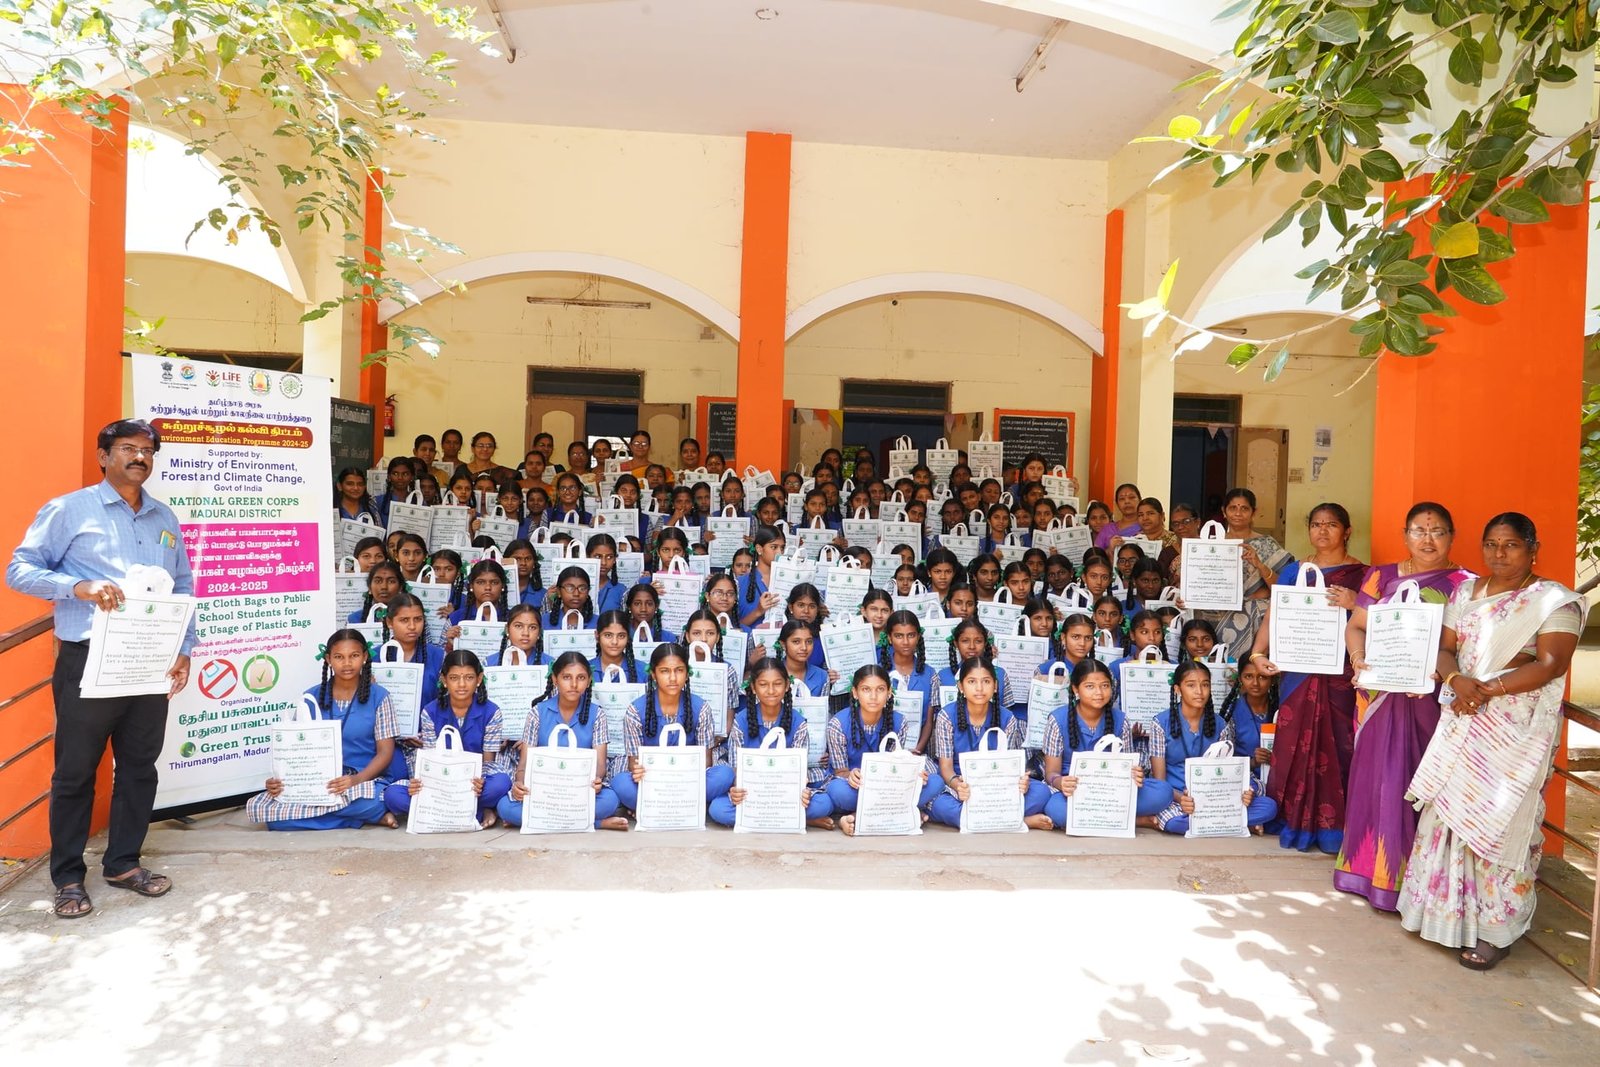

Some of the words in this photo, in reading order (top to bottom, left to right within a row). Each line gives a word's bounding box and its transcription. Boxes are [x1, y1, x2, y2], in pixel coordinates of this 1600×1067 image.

[222, 372, 241, 382] LiFE
[201, 407, 228, 418] மற்றும்
[162, 420, 236, 434] சுற்றுச்சூழல்
[237, 424, 269, 435] கல்வி
[270, 427, 303, 437] திட்டம்
[205, 436, 241, 444] Education
[243, 437, 281, 446] Programme
[282, 440, 309, 448] 2024-25
[208, 449, 249, 457] Supported
[251, 451, 263, 459] by:
[170, 458, 214, 470] Ministry
[217, 459, 228, 469] of
[231, 459, 298, 472] Environment,
[161, 471, 198, 482] Forest
[199, 472, 221, 482] and
[223, 473, 262, 483] Climate
[265, 474, 306, 485] Change,
[214, 484, 233, 492] Govt
[234, 484, 242, 492] of
[244, 484, 263, 492] India
[169, 497, 225, 506] NATIONAL
[228, 497, 263, 506] GREEN
[266, 497, 300, 506] CORPS
[190, 509, 237, 518] MADURAI
[239, 508, 282, 518] DISTRICT
[227, 563, 274, 578] வழங்கும்
[275, 561, 314, 577] நிகழ்ச்சி
[207, 581, 269, 594] 2024-2025
[213, 598, 241, 608] Cloth
[244, 597, 267, 608] Bags
[270, 596, 280, 604] to
[283, 593, 311, 604] Public
[199, 611, 234, 622] School
[237, 609, 281, 619] Students
[284, 607, 298, 616] for
[209, 625, 239, 635] Usage
[242, 622, 253, 632] of
[255, 620, 288, 630] Plastic
[291, 619, 312, 629] Bags
[220, 697, 253, 707] Organized
[178, 710, 218, 726] தேசிய
[187, 725, 228, 739] மதுரை
[200, 740, 239, 754] Green
[243, 734, 271, 746] Trus
[169, 753, 242, 770] Thirumangalam,
[243, 746, 271, 758] Madur
